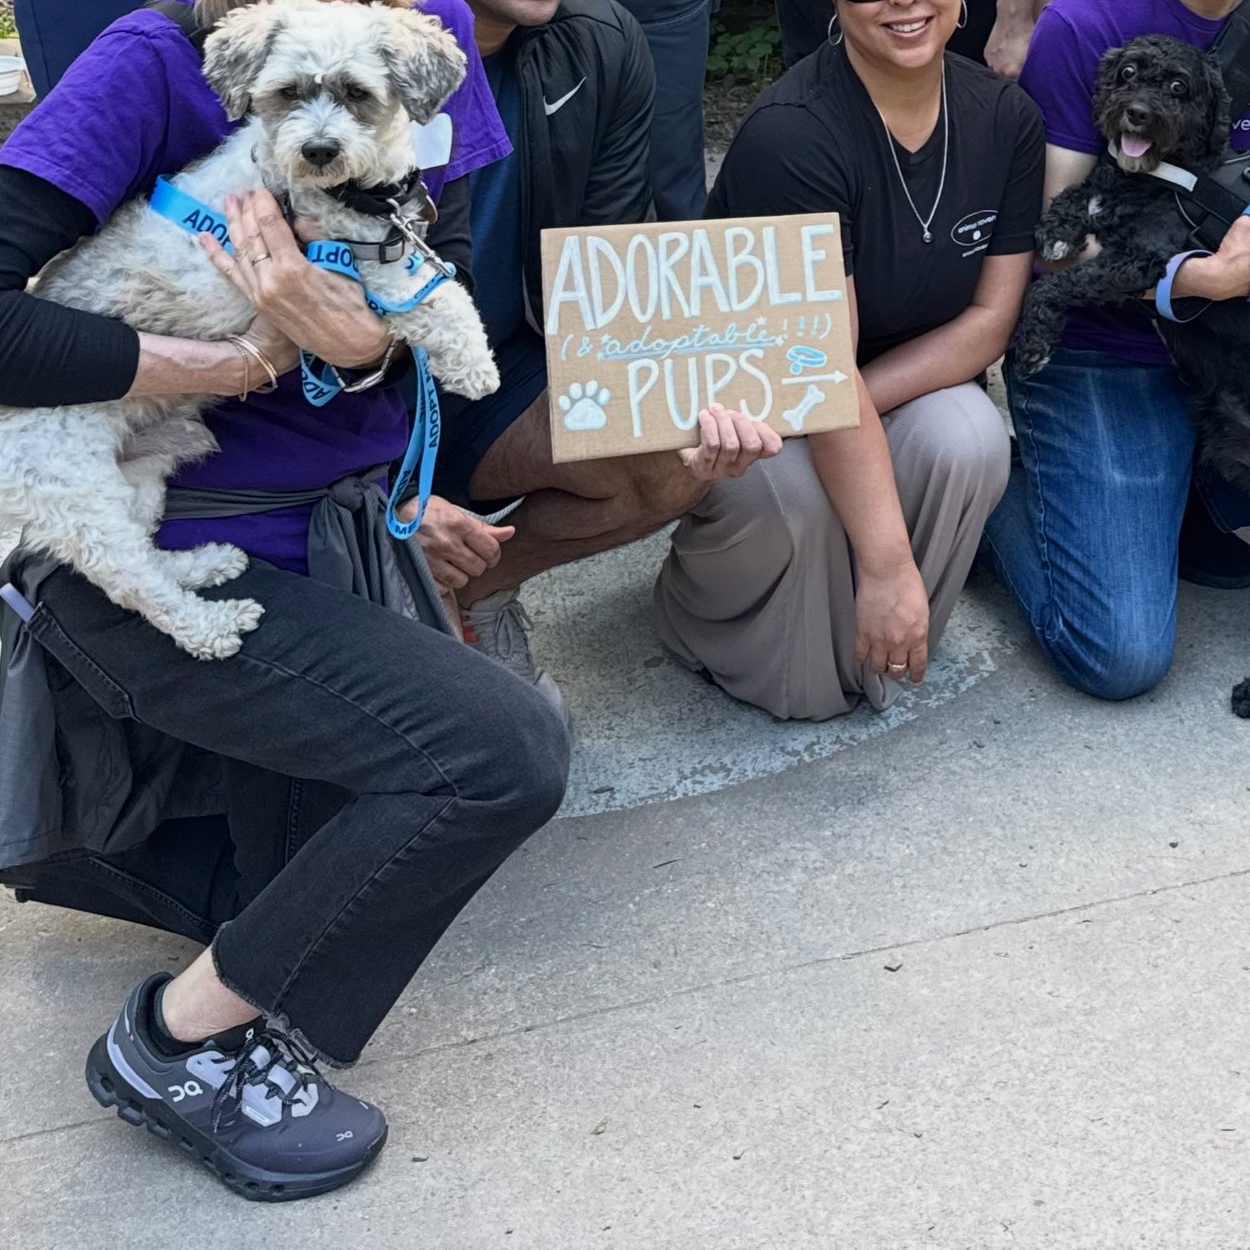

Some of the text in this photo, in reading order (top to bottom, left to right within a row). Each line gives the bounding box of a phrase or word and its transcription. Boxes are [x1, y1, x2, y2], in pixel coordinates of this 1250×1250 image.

[547, 224, 842, 334] ADORABLE
[428, 390, 439, 448] ADOPT
[627, 349, 773, 437] PUPS
